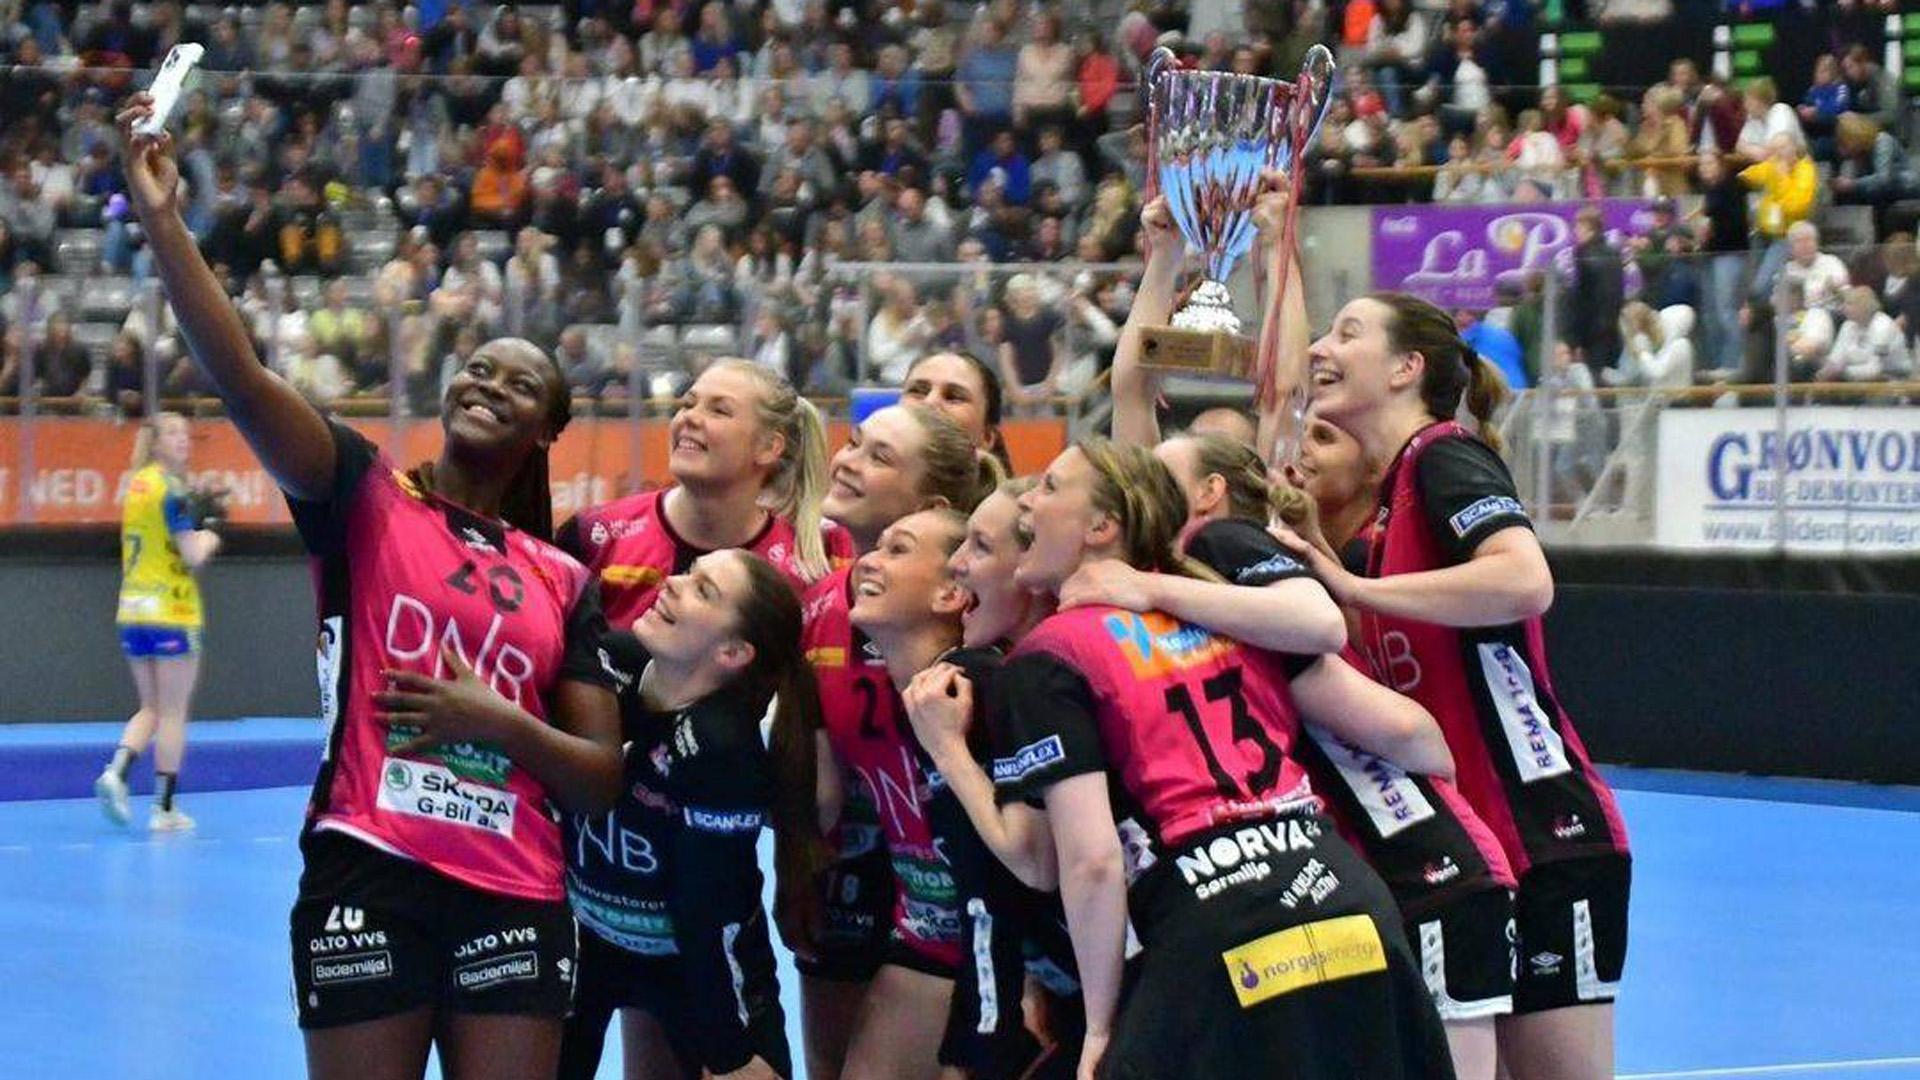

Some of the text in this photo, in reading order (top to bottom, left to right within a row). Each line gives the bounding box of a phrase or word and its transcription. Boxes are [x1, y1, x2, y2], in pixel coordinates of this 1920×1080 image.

[1402, 231, 1487, 284] La
[386, 594, 533, 706] DNB
[1164, 664, 1284, 799] 13
[1516, 704, 1553, 768] REMA
[417, 797, 472, 822] G-Bil
[573, 808, 659, 873] NB
[1175, 819, 1315, 886] NORVA
[310, 930, 387, 952] OLTO VVS
[501, 926, 537, 945] VVS
